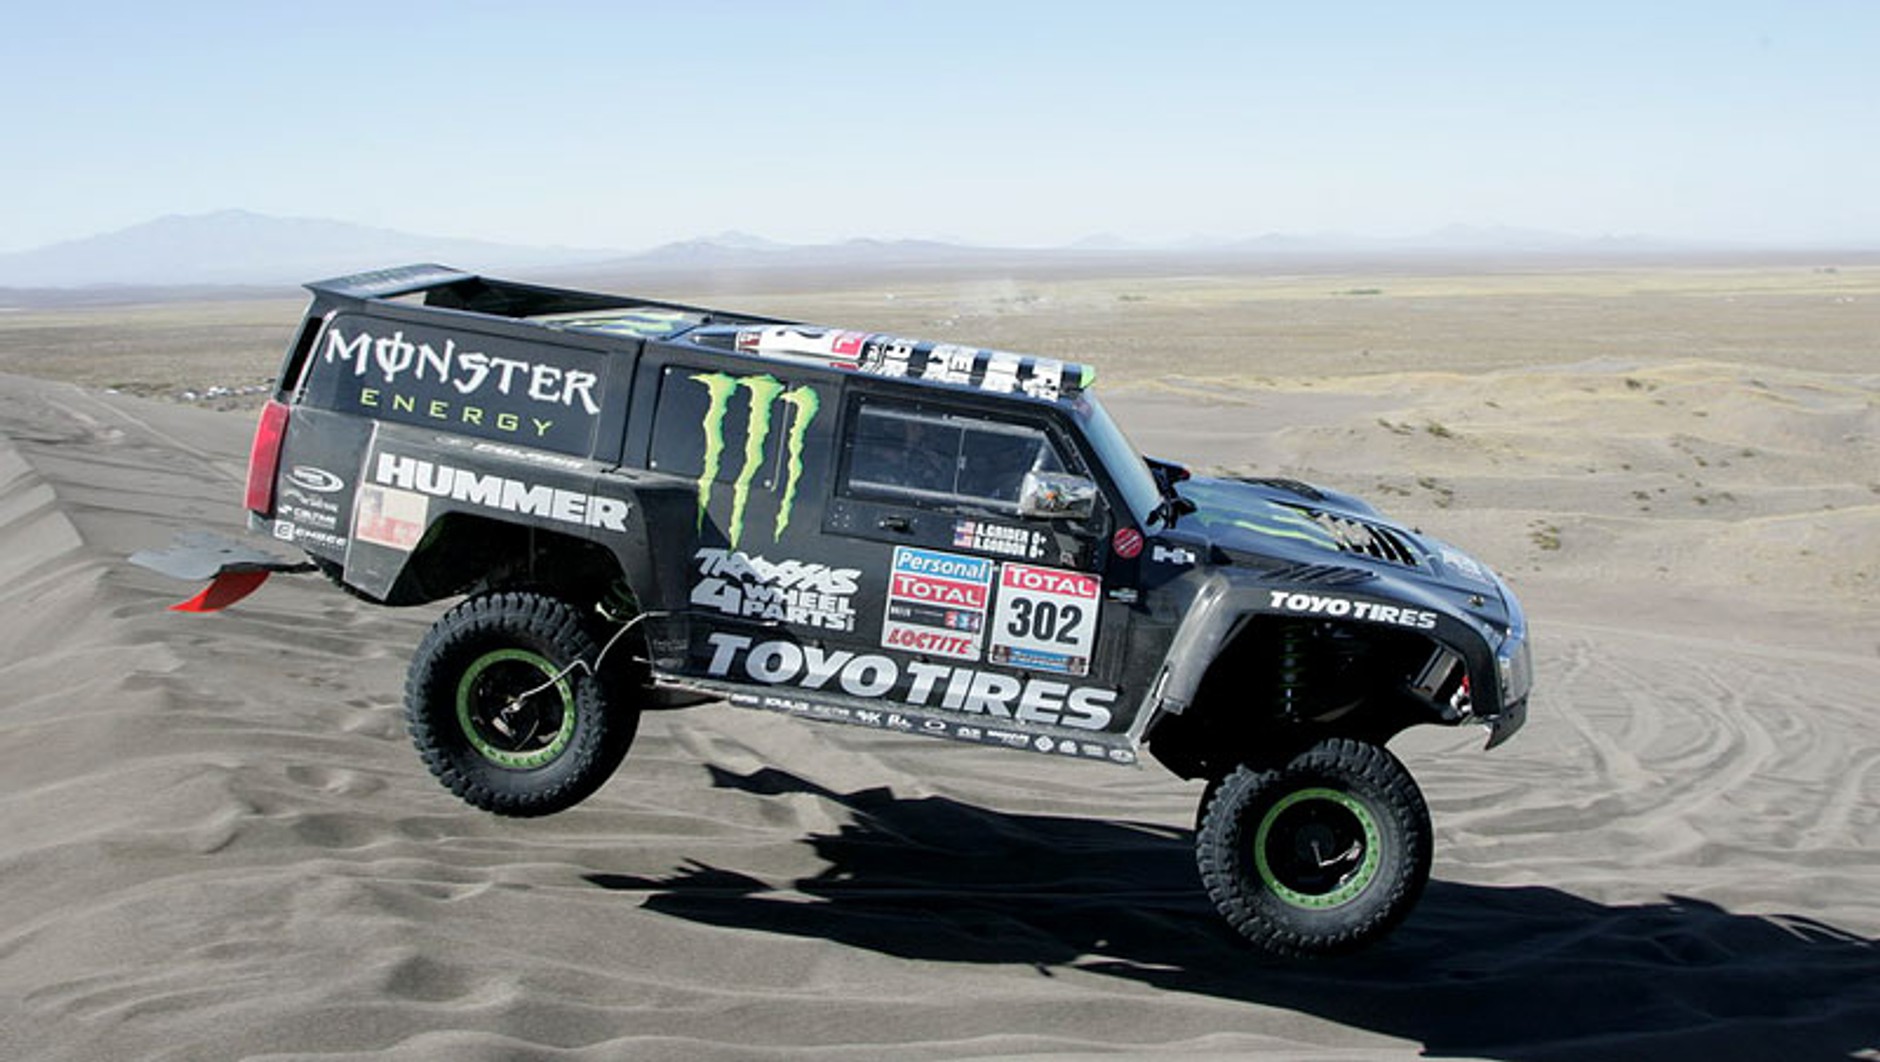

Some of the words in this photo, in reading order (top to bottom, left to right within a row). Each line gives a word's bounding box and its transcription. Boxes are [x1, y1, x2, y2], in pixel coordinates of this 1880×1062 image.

[324, 328, 600, 415] MONSTER
[359, 387, 553, 437] ENERGY
[376, 452, 632, 533] HUMMER
[695, 547, 862, 595] TRAXXAS
[898, 551, 987, 582] Personal
[1009, 565, 1095, 596] TOTAL
[690, 577, 742, 615] 4
[743, 582, 856, 615] WHEEL
[897, 575, 982, 606] TOTAL
[1269, 590, 1349, 615] TOYO
[1350, 598, 1438, 629] TIRES
[743, 599, 847, 632] PARTS
[1008, 597, 1083, 645] 302
[888, 628, 974, 655] LOCTITE
[707, 631, 899, 697] TOYO
[905, 660, 1118, 732] TIRES
